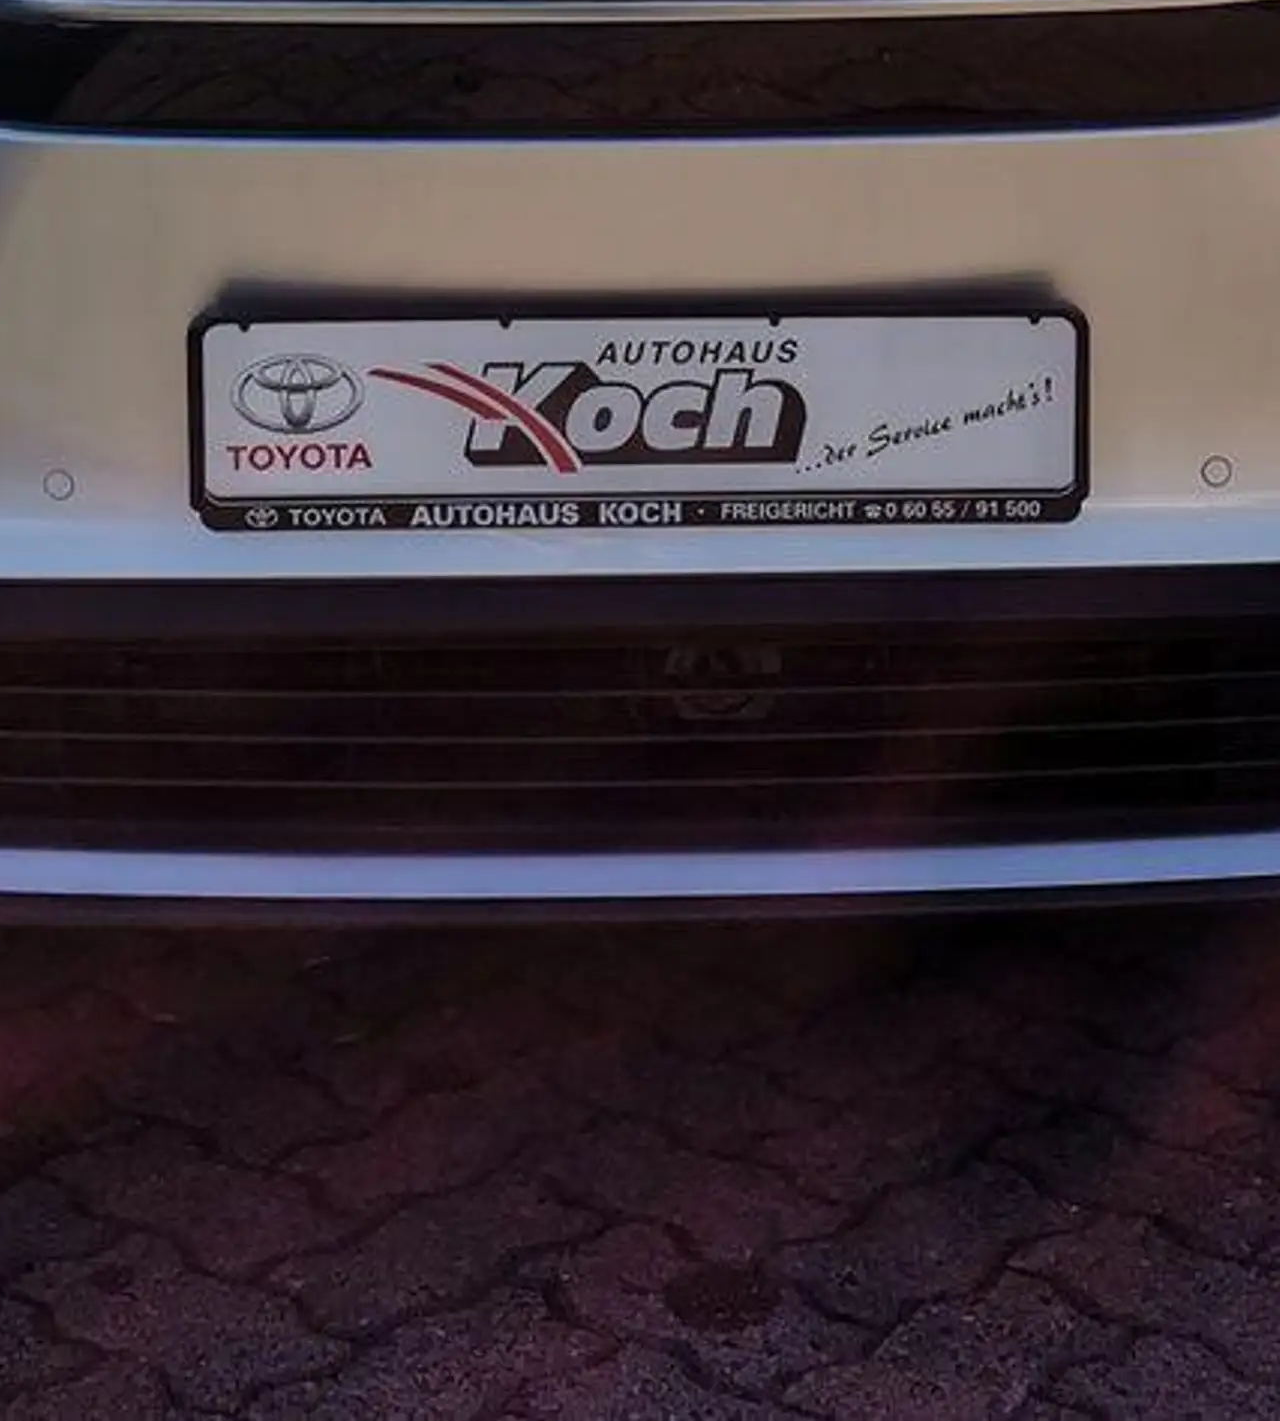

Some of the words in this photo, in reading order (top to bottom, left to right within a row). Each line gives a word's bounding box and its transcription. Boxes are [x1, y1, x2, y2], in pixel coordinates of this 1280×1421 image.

[596, 340, 799, 364] AUTOHAUS
[467, 362, 806, 465] Koch
[867, 416, 951, 458] Service
[226, 443, 373, 471] TOYOTA
[288, 508, 387, 527] TOYOTA
[410, 504, 580, 527] AUTOHAUS
[599, 502, 682, 524] KOCH
[720, 500, 856, 520] FREIGERICHT
[977, 500, 999, 517] 91
[1006, 499, 1041, 517] 500
